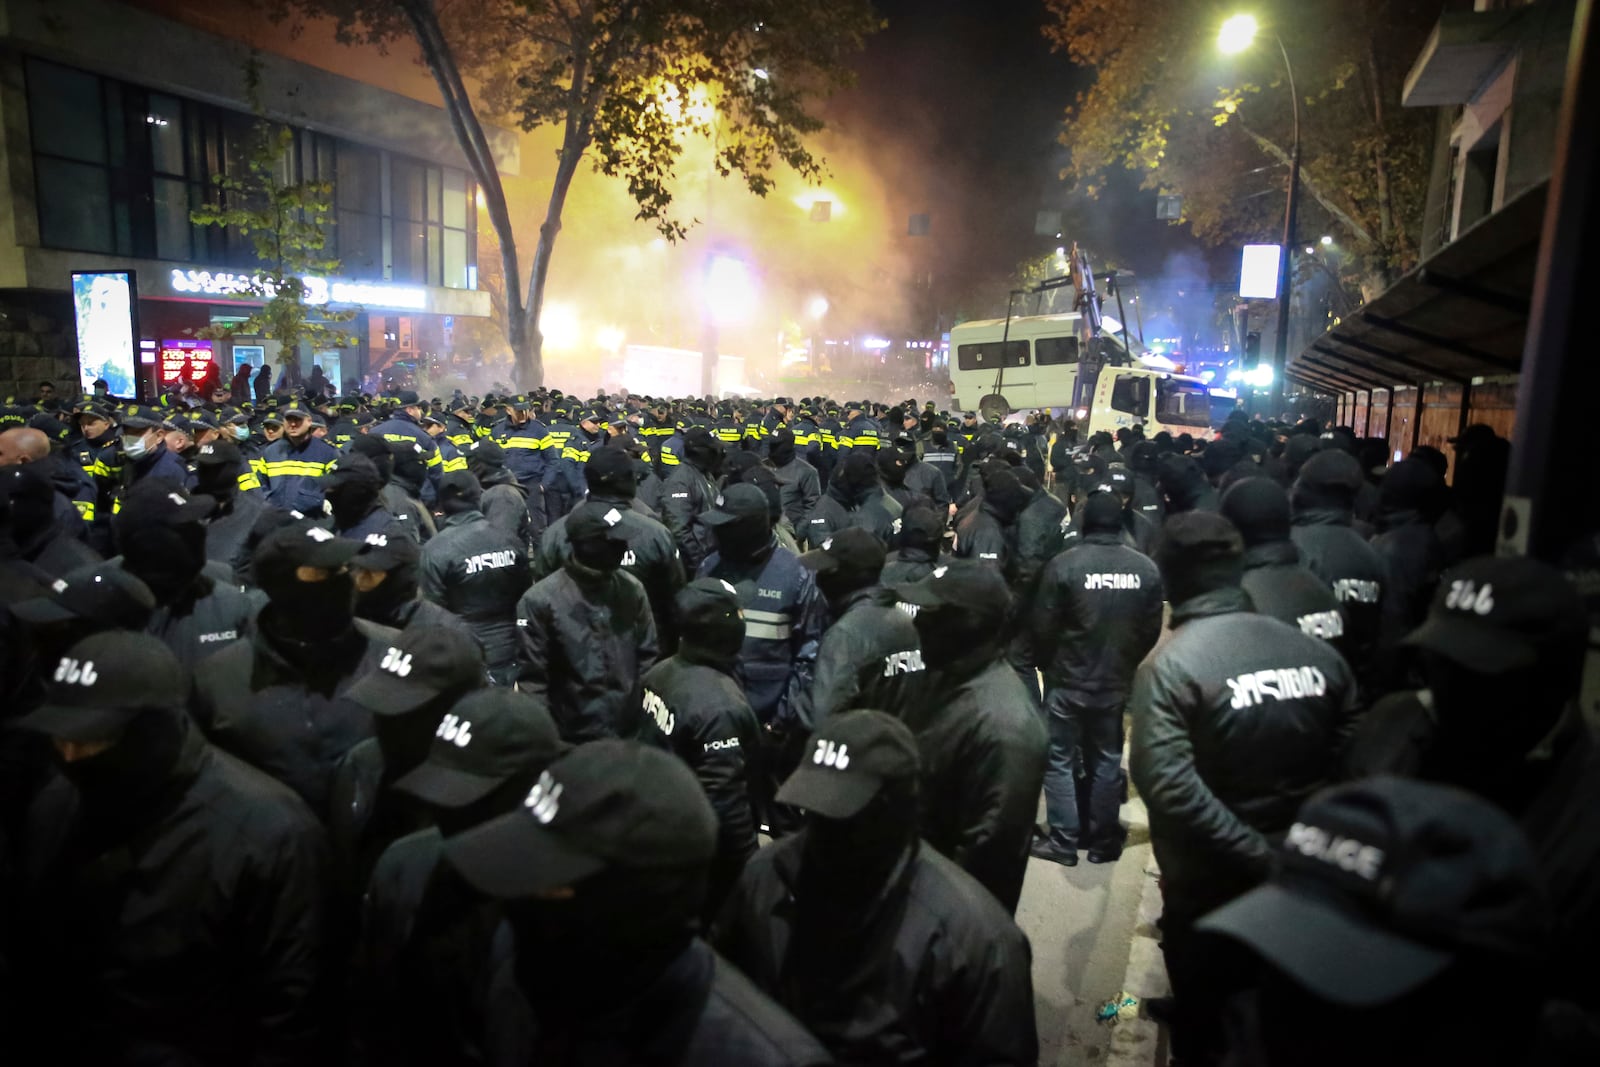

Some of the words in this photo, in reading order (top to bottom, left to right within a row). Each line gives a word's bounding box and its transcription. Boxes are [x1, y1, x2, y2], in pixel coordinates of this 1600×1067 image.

[758, 588, 782, 600] OLICE
[1084, 573, 1141, 590] პოლიცია
[1445, 579, 1495, 616] შსს
[199, 630, 238, 644] POLICE
[53, 656, 99, 687] შსს
[380, 646, 413, 678] შსს
[1226, 665, 1326, 710] პოლიცია
[436, 713, 473, 749] შსს
[813, 738, 851, 771] შსს
[1283, 821, 1385, 881] POLICE
